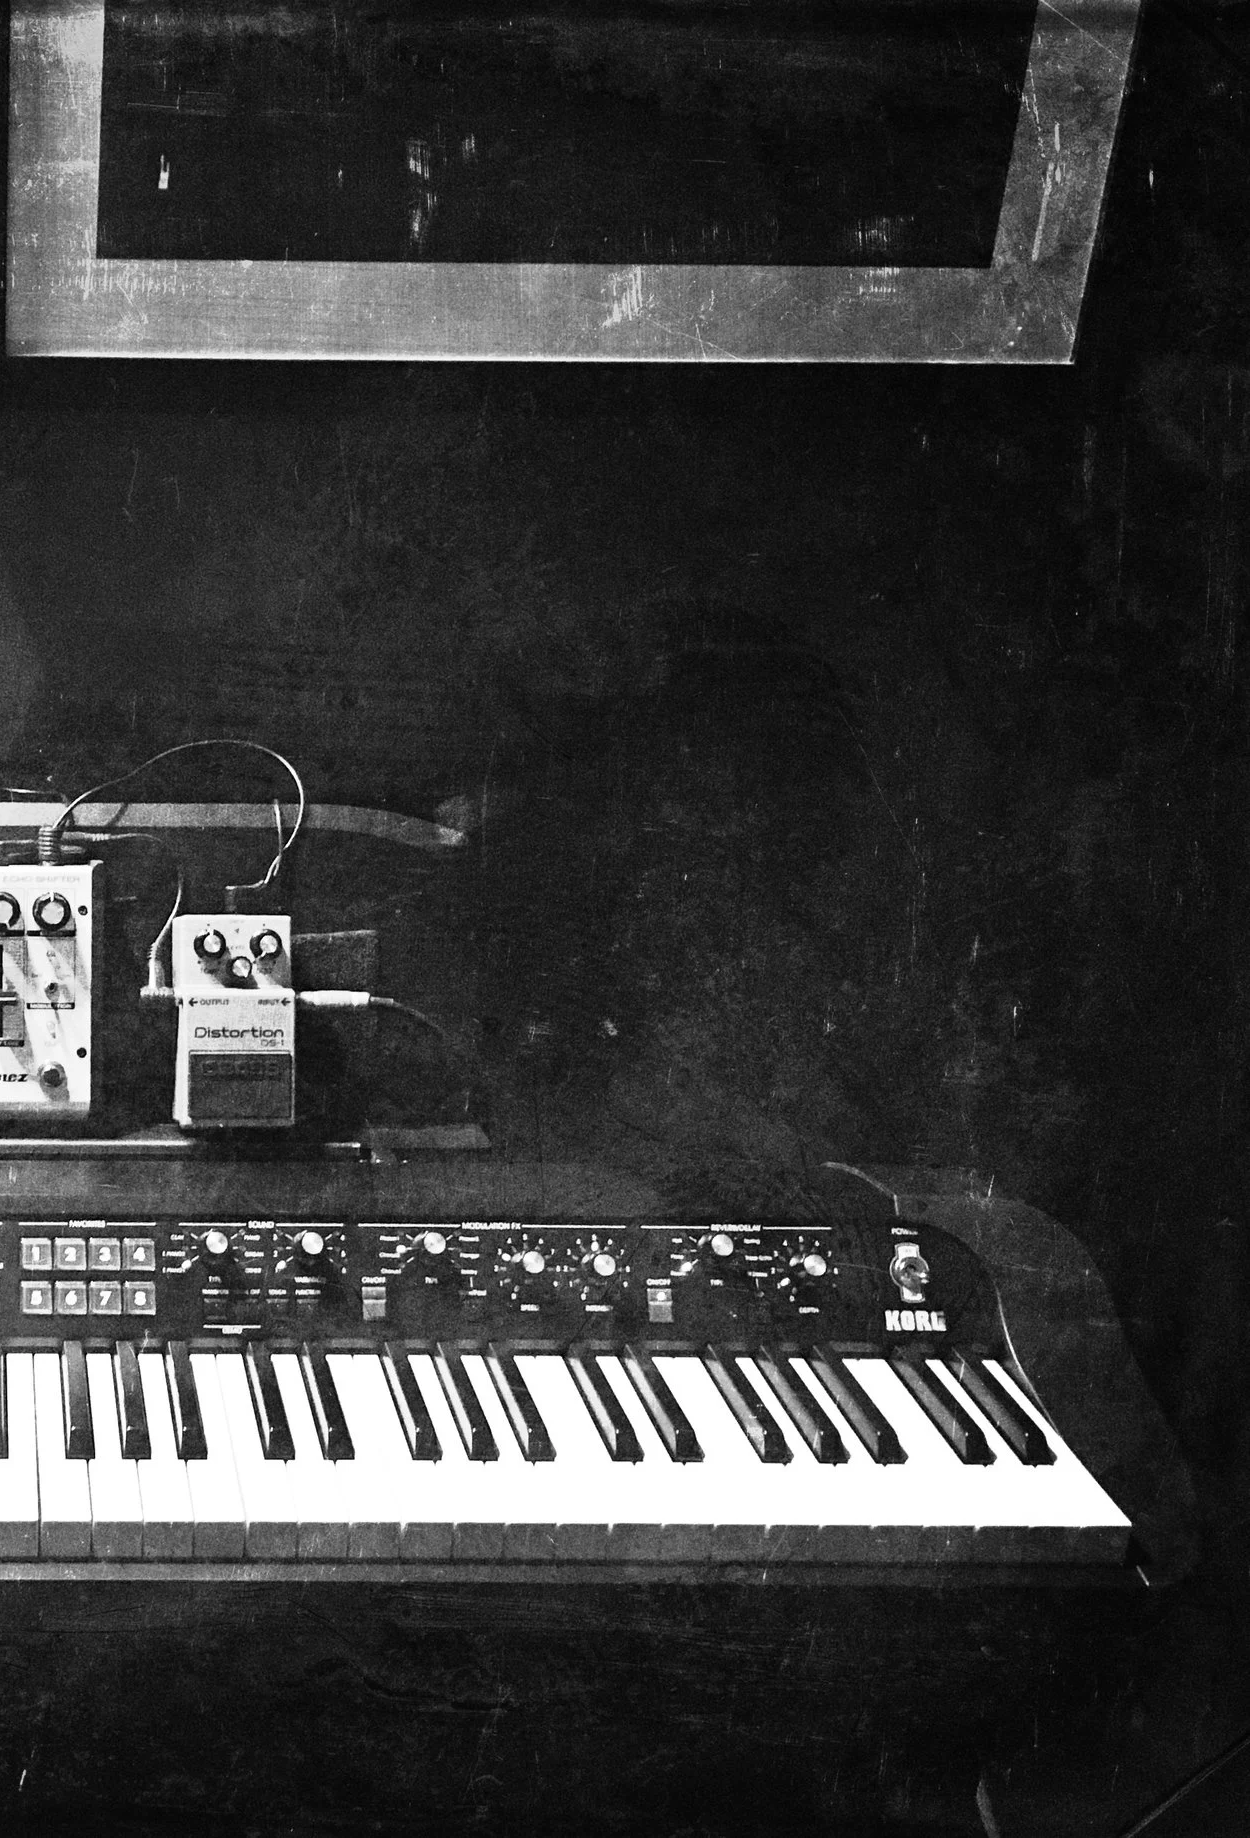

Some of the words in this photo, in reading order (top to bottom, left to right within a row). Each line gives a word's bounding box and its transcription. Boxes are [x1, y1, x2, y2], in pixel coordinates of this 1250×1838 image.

[194, 1027, 285, 1039] Distortion
[260, 1039, 285, 1047] DS-1
[247, 1221, 275, 1229] SOUND
[461, 1222, 510, 1230] MODULATION
[511, 1222, 521, 1230] FX
[31, 1246, 40, 1262] 1
[64, 1246, 77, 1262] 2
[99, 1246, 111, 1262] 3
[133, 1246, 146, 1262] 4
[30, 1290, 43, 1306] 5
[65, 1290, 78, 1306] 6
[99, 1290, 112, 1306] 7
[134, 1290, 147, 1306] 8
[884, 1309, 947, 1332] KORG
